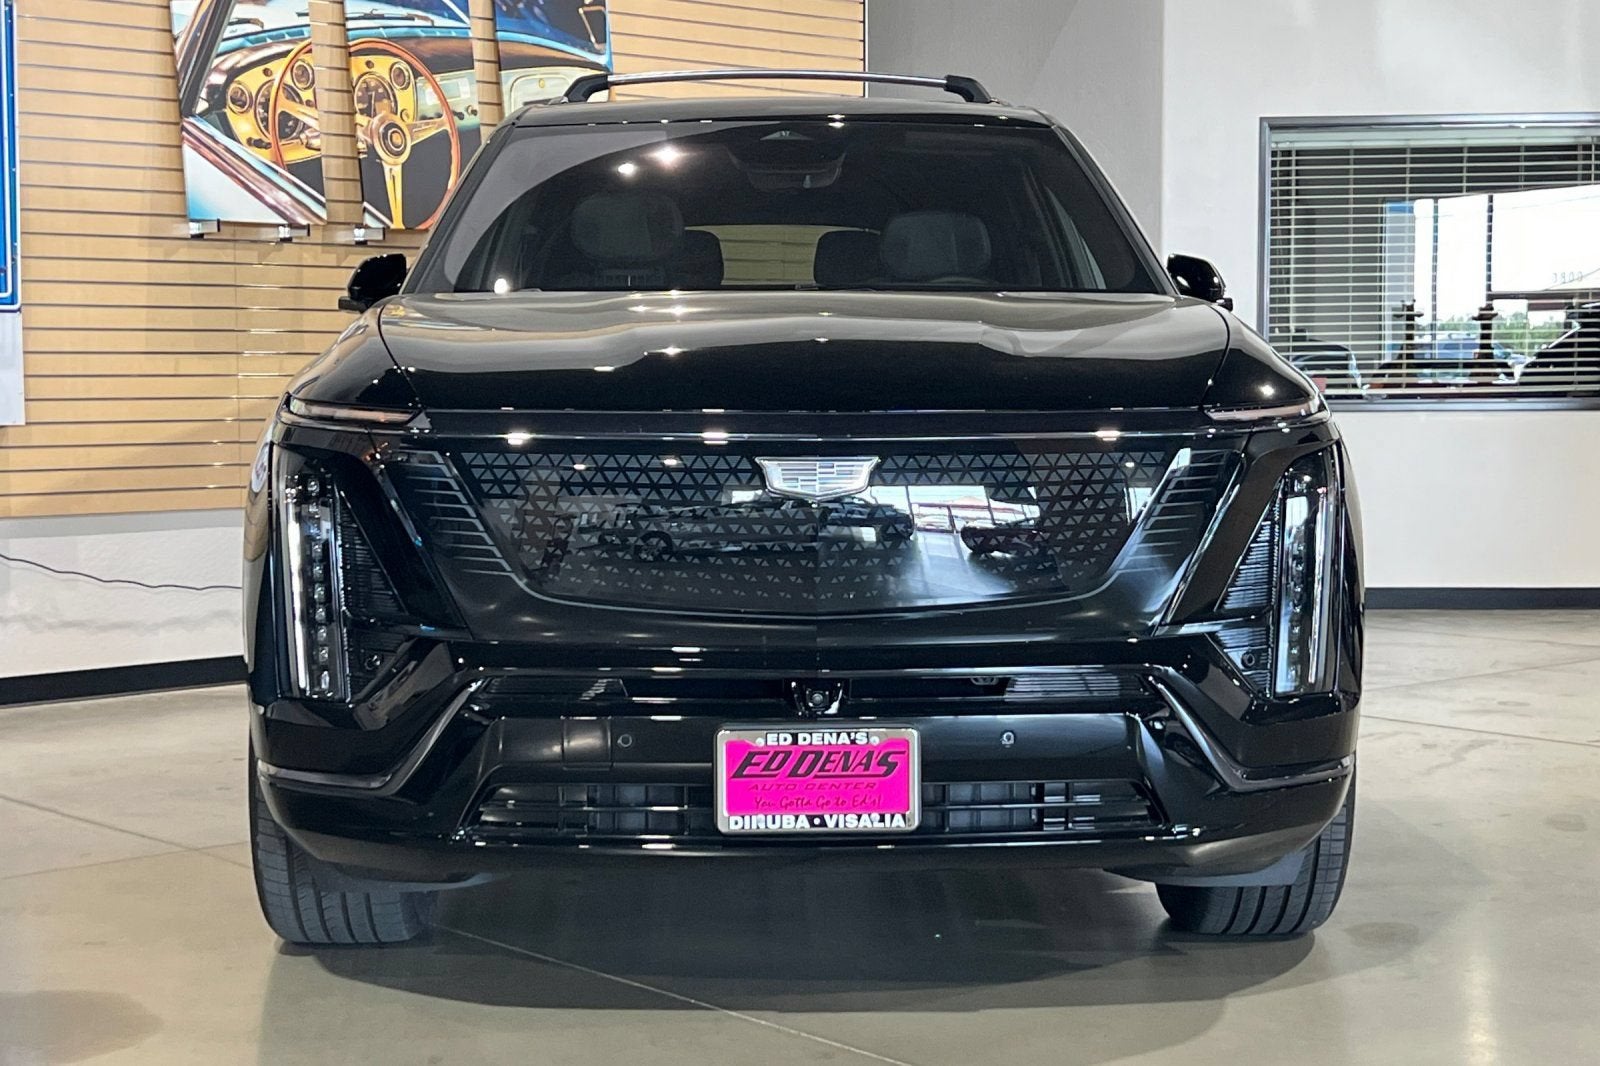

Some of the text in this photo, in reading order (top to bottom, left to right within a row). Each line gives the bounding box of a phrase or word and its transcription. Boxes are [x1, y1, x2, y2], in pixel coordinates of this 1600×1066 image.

[766, 732, 868, 746] ED DENA'S
[731, 750, 907, 779] ED DENA'S
[748, 782, 877, 791] AUTO CENTER
[754, 797, 775, 809] You
[780, 796, 811, 809] Gotta
[816, 796, 831, 809] Go
[834, 795, 847, 806] to
[729, 813, 906, 829] DINUBA VISALIA
